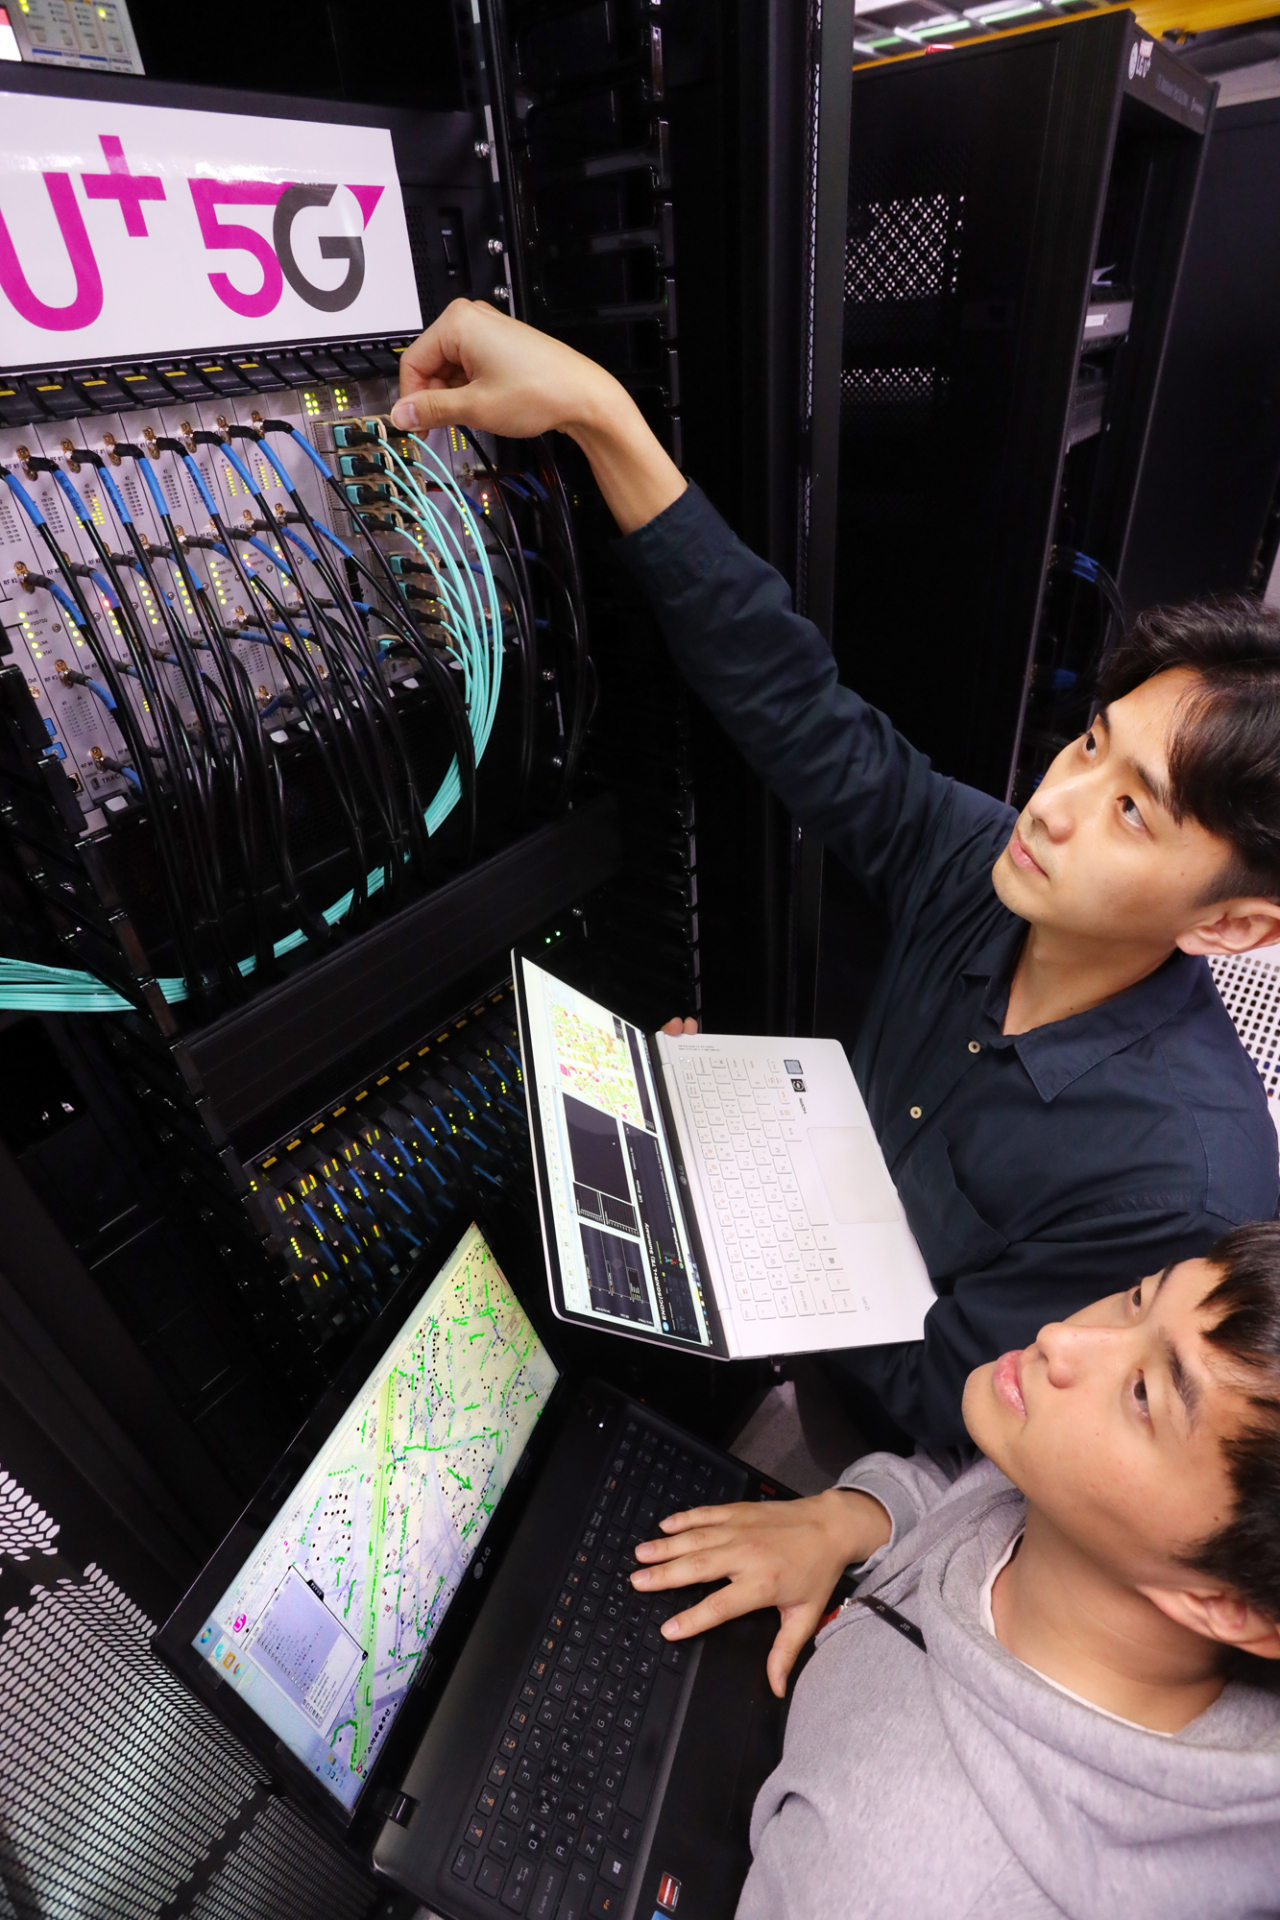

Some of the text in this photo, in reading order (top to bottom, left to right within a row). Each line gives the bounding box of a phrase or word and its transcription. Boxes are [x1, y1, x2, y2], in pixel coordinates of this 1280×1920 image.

[0, 135, 385, 331] U+ 5G
[101, 774, 120, 784] TRXC
[643, 1221, 656, 1256] Summary
[481, 1546, 491, 1563] LG
[616, 1583, 624, 1592] P
[574, 1630, 582, 1638] 8
[624, 1638, 632, 1647] K
[564, 1656, 572, 1664] 7
[591, 1657, 600, 1667] U
[640, 1662, 649, 1672] M
[582, 1684, 590, 1692] Y
[606, 1690, 614, 1700] H
[632, 1690, 641, 1700] N
[544, 1712, 552, 1720] 5
[572, 1712, 580, 1720] T
[597, 1718, 605, 1728] G
[624, 1718, 632, 1728] B
[504, 1738, 510, 1746] F4
[534, 1740, 541, 1749] 4
[562, 1742, 571, 1752] R
[587, 1750, 595, 1758] F
[614, 1746, 623, 1756] V
[492, 1764, 500, 1774] F3
[522, 1772, 531, 1781] 3
[551, 1774, 560, 1783] E
[606, 1778, 614, 1788] C
[482, 1794, 490, 1803] F2
[510, 1804, 519, 1814] 2
[540, 1802, 550, 1814] W
[566, 1812, 576, 1822] S
[596, 1810, 605, 1820] X
[528, 1838, 538, 1850] Q
[556, 1846, 565, 1856] A
[586, 1844, 596, 1855] Z
[458, 1854, 466, 1867] Esc
[538, 1875, 554, 1914] Caps Lock
[603, 1899, 610, 1910] Fn
